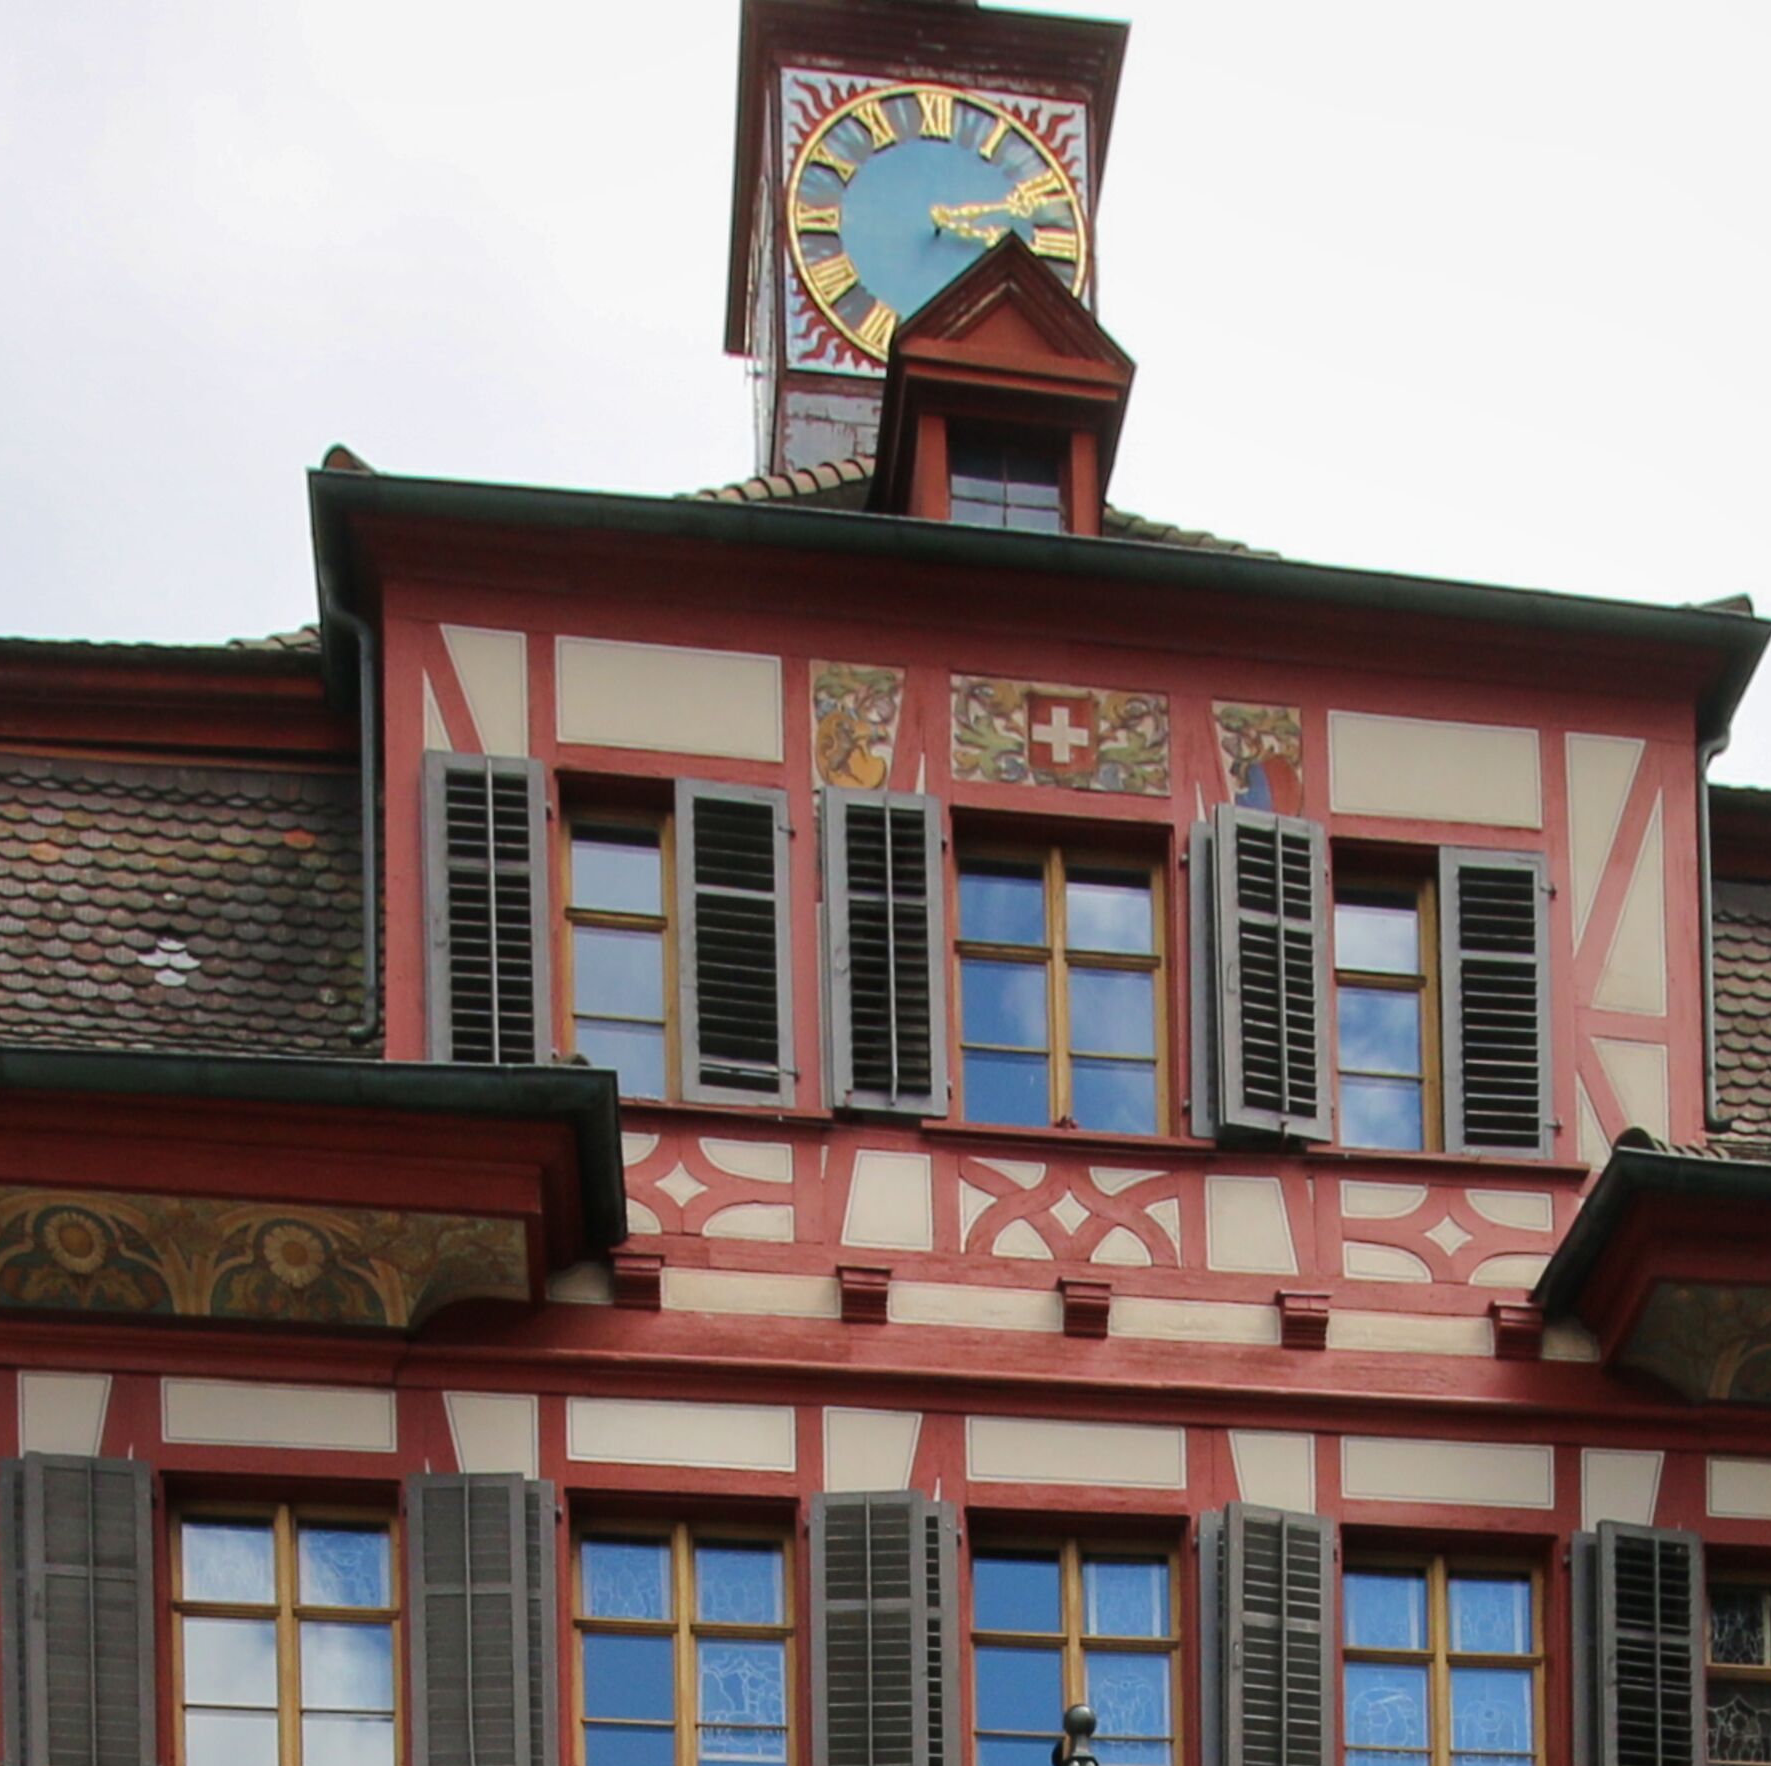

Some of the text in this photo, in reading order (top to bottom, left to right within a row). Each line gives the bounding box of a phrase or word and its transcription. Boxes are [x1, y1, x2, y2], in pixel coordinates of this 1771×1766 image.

[852, 100, 897, 149] XI
[916, 92, 954, 139] XII
[979, 118, 1010, 158] I
[810, 142, 857, 183] X
[797, 202, 839, 232] IX
[1030, 228, 1078, 259] III
[809, 254, 858, 305] VIII
